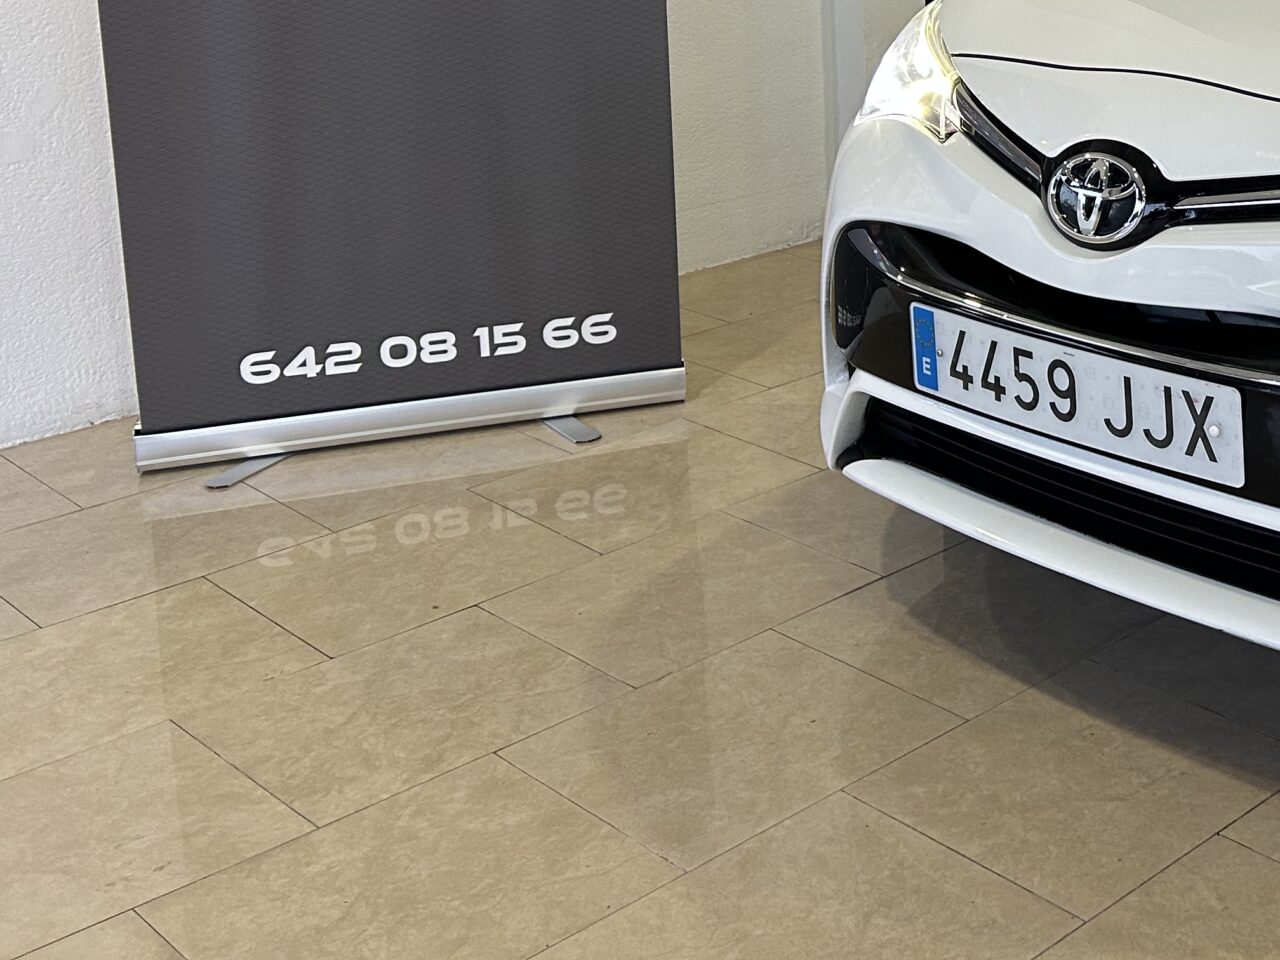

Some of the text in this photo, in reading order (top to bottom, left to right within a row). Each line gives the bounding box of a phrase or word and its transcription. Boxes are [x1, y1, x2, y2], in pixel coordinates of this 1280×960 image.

[239, 312, 617, 384] 642 08 15 66
[922, 356, 932, 376] E
[949, 330, 1218, 464] 4459 JJX
